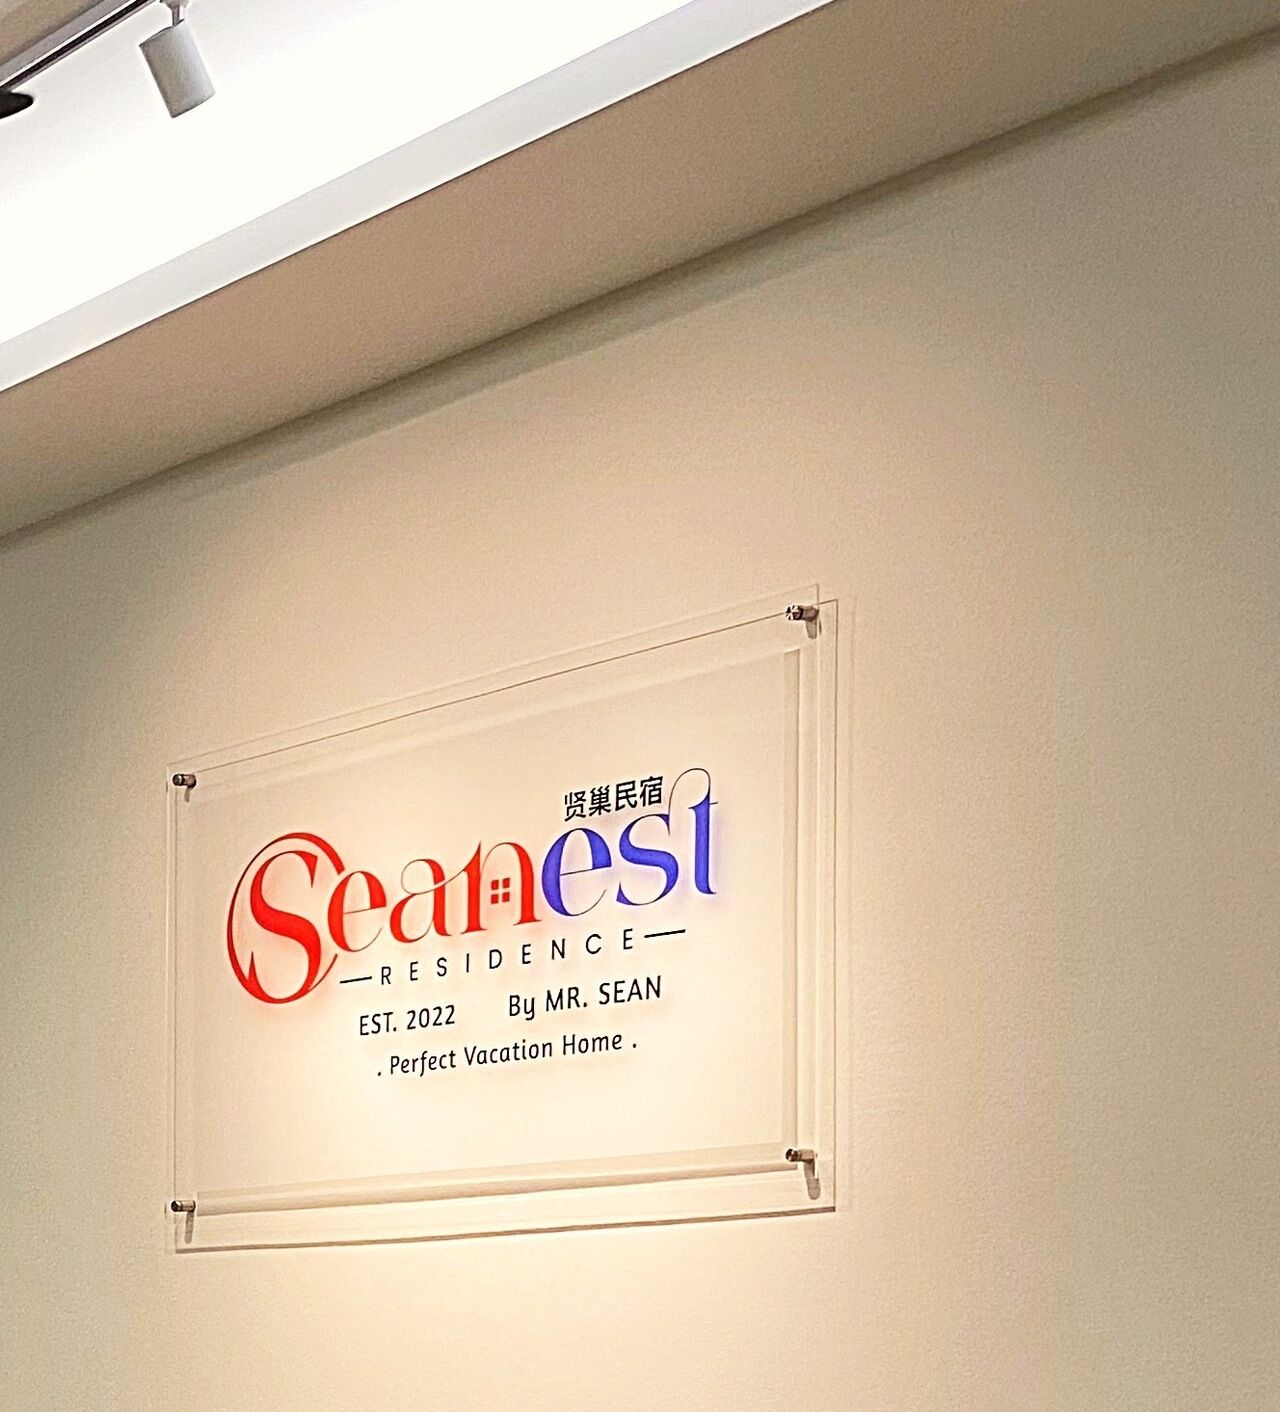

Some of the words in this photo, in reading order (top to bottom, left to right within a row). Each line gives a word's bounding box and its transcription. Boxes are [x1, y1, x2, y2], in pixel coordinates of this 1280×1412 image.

[564, 776, 663, 822] 贤巢民宿
[227, 768, 718, 1004] Seanest
[380, 928, 634, 985] RESIDENCE
[359, 1013, 397, 1036] EST.
[406, 1005, 456, 1030] 2022
[508, 994, 535, 1021] By
[545, 987, 588, 1012] MR.
[598, 976, 662, 1005] SEAN
[390, 1052, 456, 1077] Perfect
[464, 1039, 553, 1066] Vacation
[562, 1034, 623, 1055] Home
